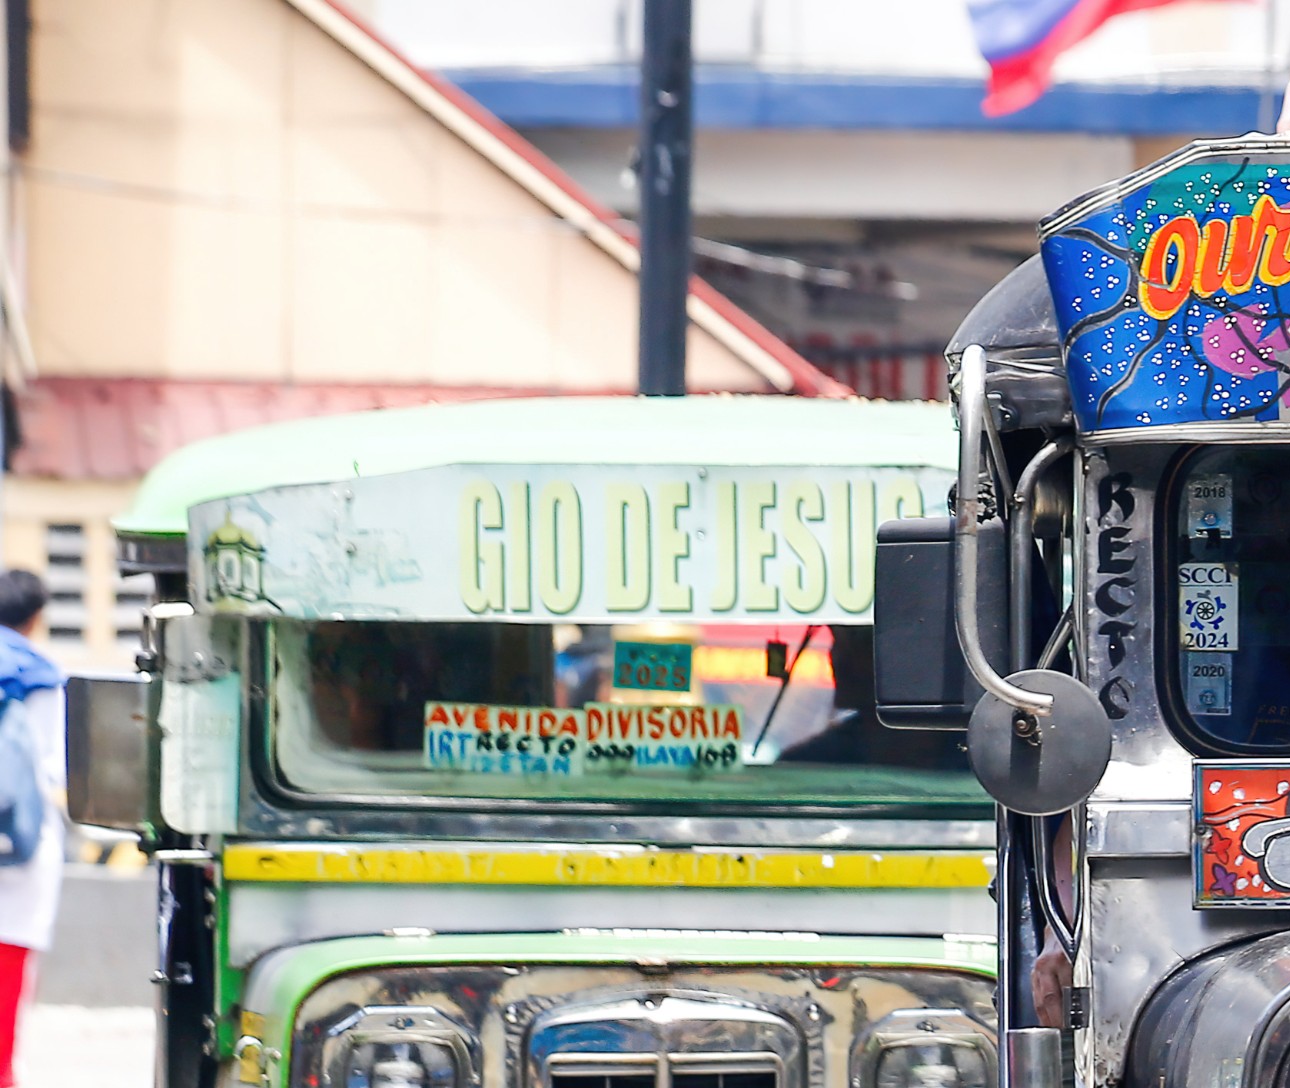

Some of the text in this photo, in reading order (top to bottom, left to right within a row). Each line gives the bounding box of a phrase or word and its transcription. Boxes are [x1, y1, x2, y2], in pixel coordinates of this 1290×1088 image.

[1194, 487, 1226, 498] 2018
[458, 480, 924, 614] GIO DE JESU
[1095, 471, 1138, 720] RECTO
[1185, 632, 1229, 648] 2024
[619, 665, 686, 687] 2025
[1193, 665, 1225, 677] 2020
[426, 704, 578, 736] AVENIDA
[586, 706, 741, 741] DIVISORIA
[477, 731, 576, 756] RECTO
